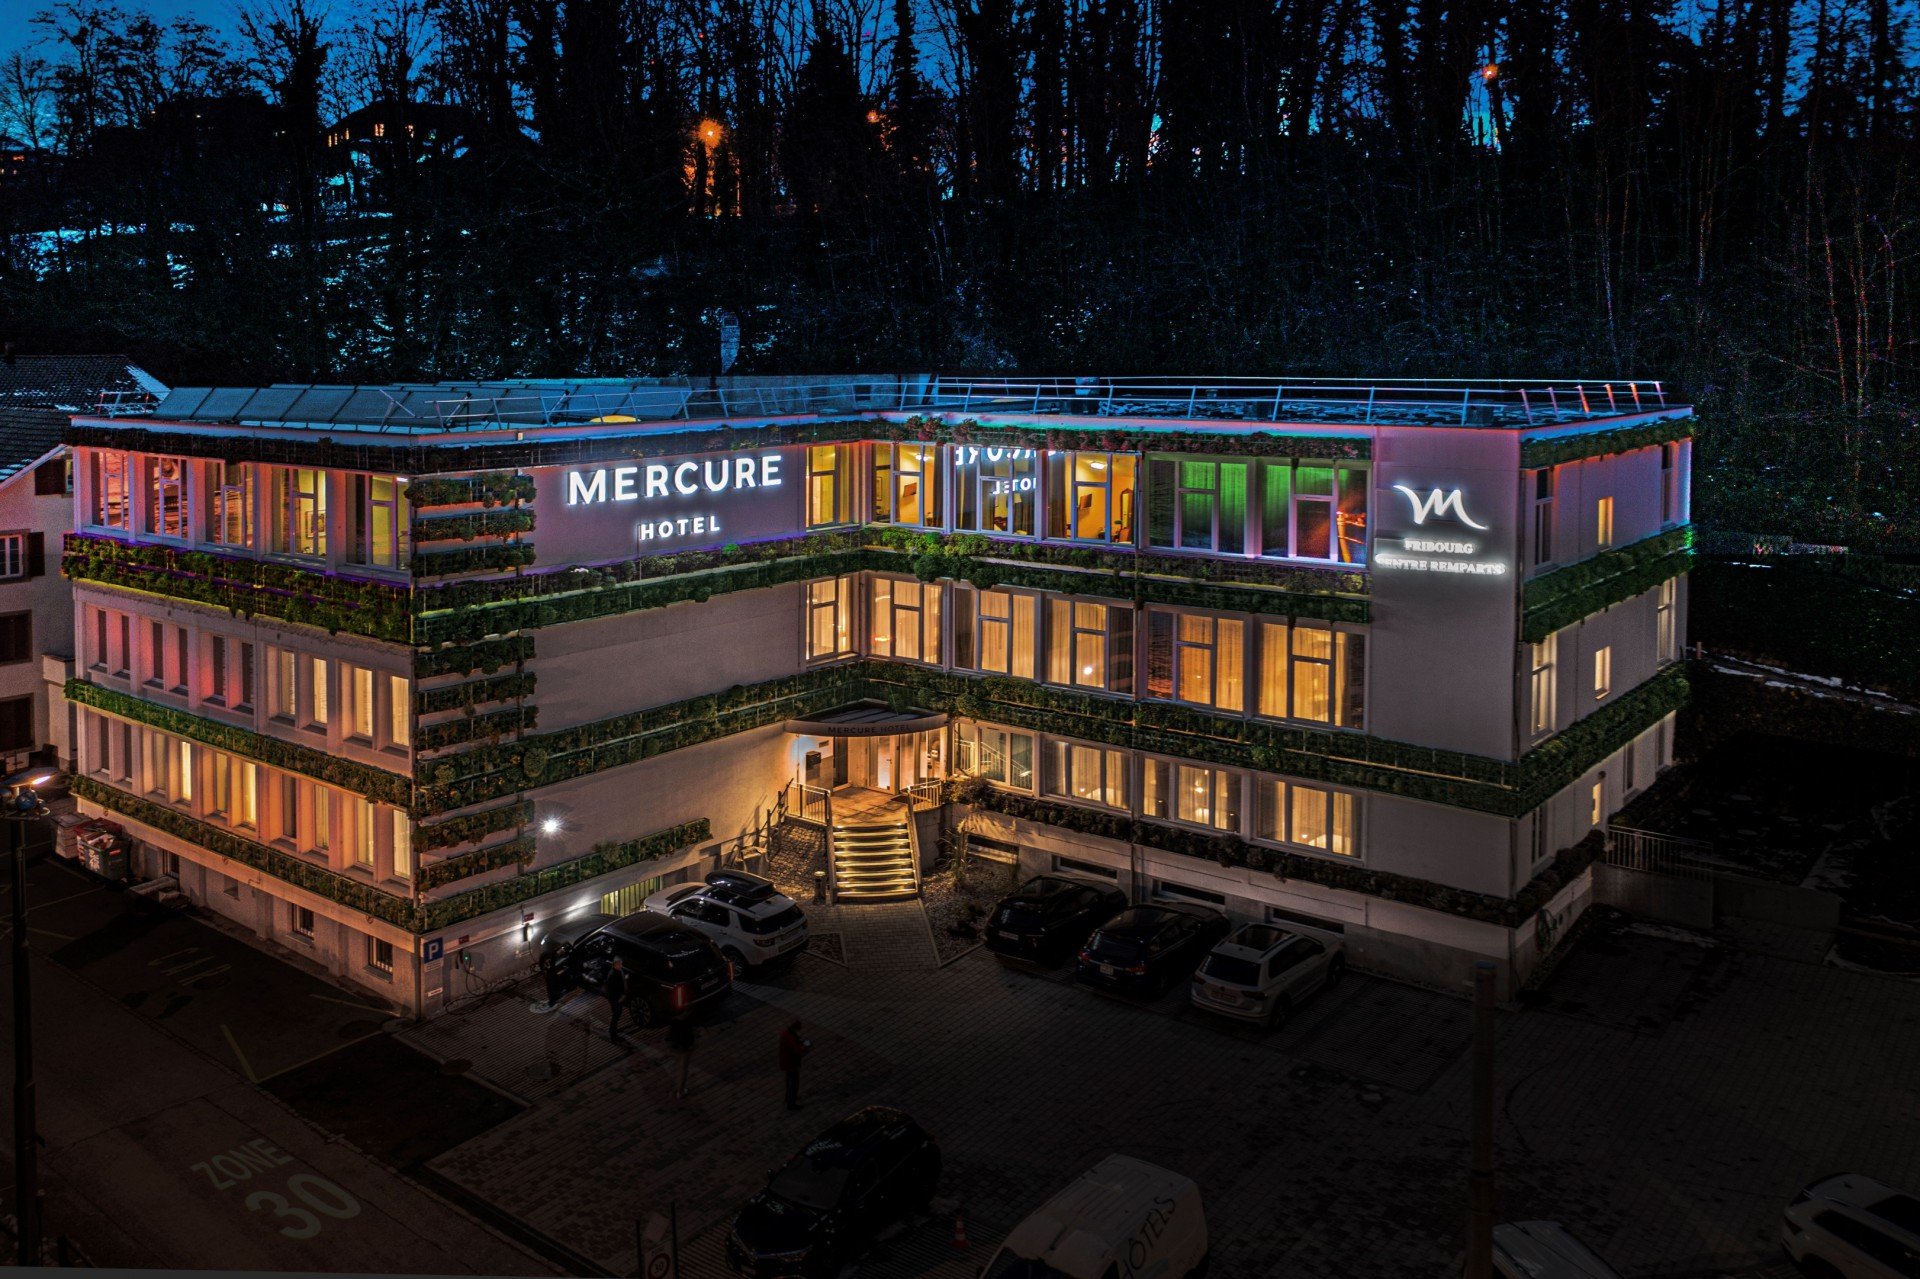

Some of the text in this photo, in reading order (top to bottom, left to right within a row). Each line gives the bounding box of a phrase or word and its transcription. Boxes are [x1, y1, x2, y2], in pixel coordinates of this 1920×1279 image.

[569, 455, 782, 505] MERCURE
[639, 515, 720, 541] HOTEL
[1404, 540, 1474, 555] FRIBOURG
[1430, 562, 1506, 575] REMPARTS
[827, 724, 910, 734] MERCURE HOTEL
[429, 942, 440, 959] P
[191, 1138, 295, 1190] ZONE
[245, 1173, 361, 1239] 30
